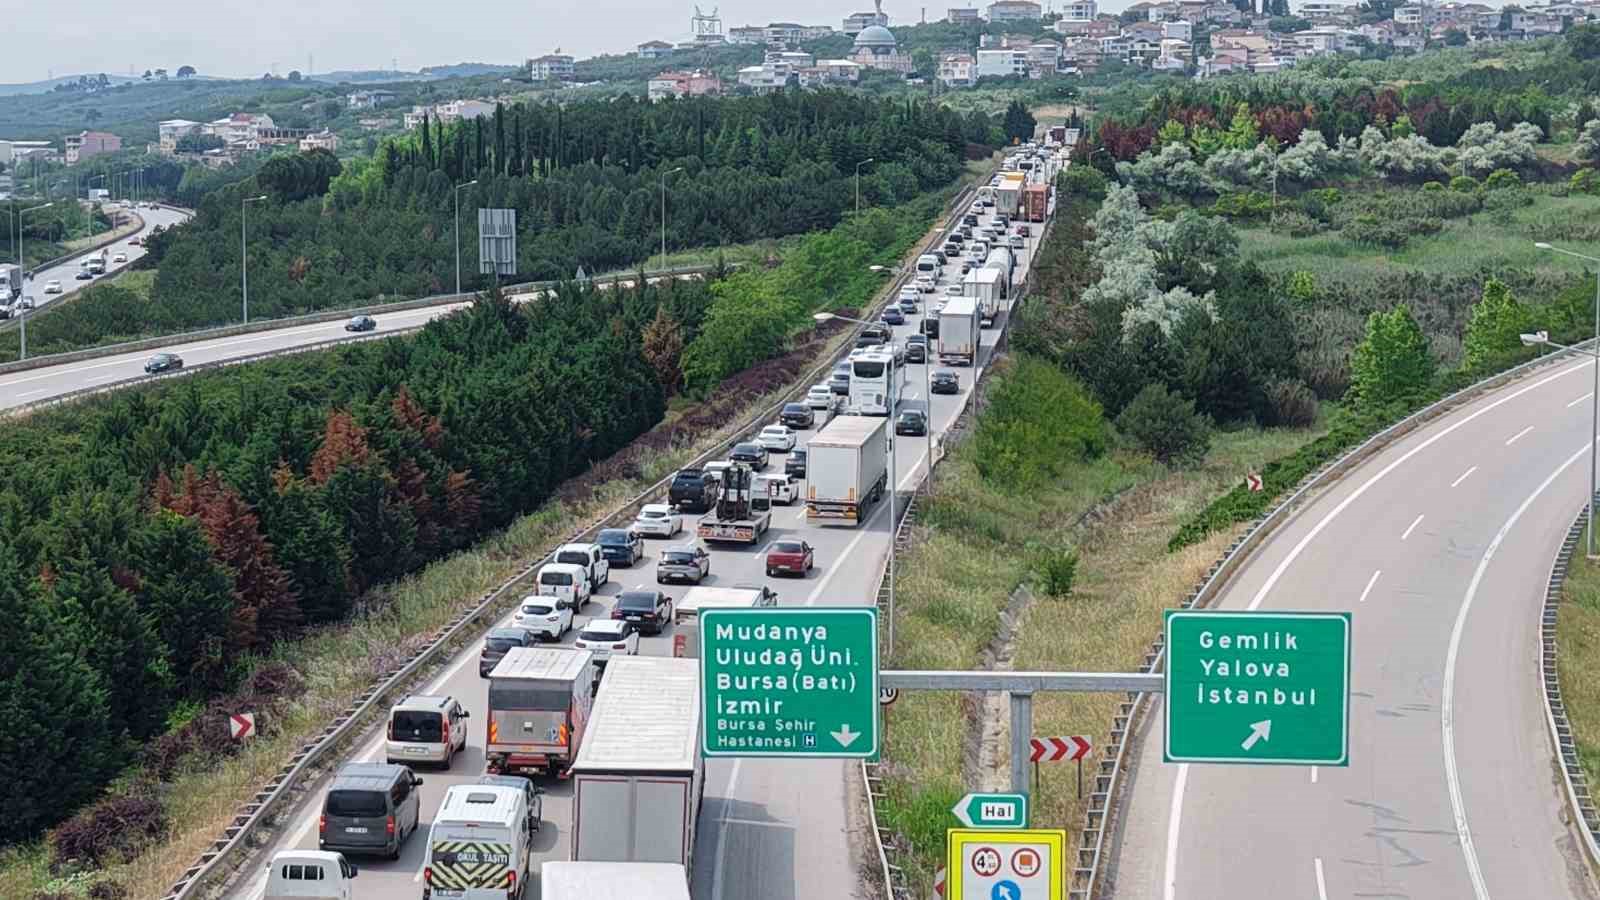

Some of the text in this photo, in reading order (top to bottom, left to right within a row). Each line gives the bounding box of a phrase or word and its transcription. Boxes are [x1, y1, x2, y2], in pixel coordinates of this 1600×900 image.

[715, 623, 827, 644] Mudanya
[1199, 631, 1298, 650] Gemlik
[715, 644, 860, 671] Uludağ Üni.
[1199, 659, 1290, 677] Yalova
[1197, 683, 1316, 705] İstanbul
[716, 693, 783, 715] İzmir
[717, 719, 816, 732] Bursa Şehir
[717, 735, 797, 747] Hastanesi
[985, 805, 1012, 817] Hal
